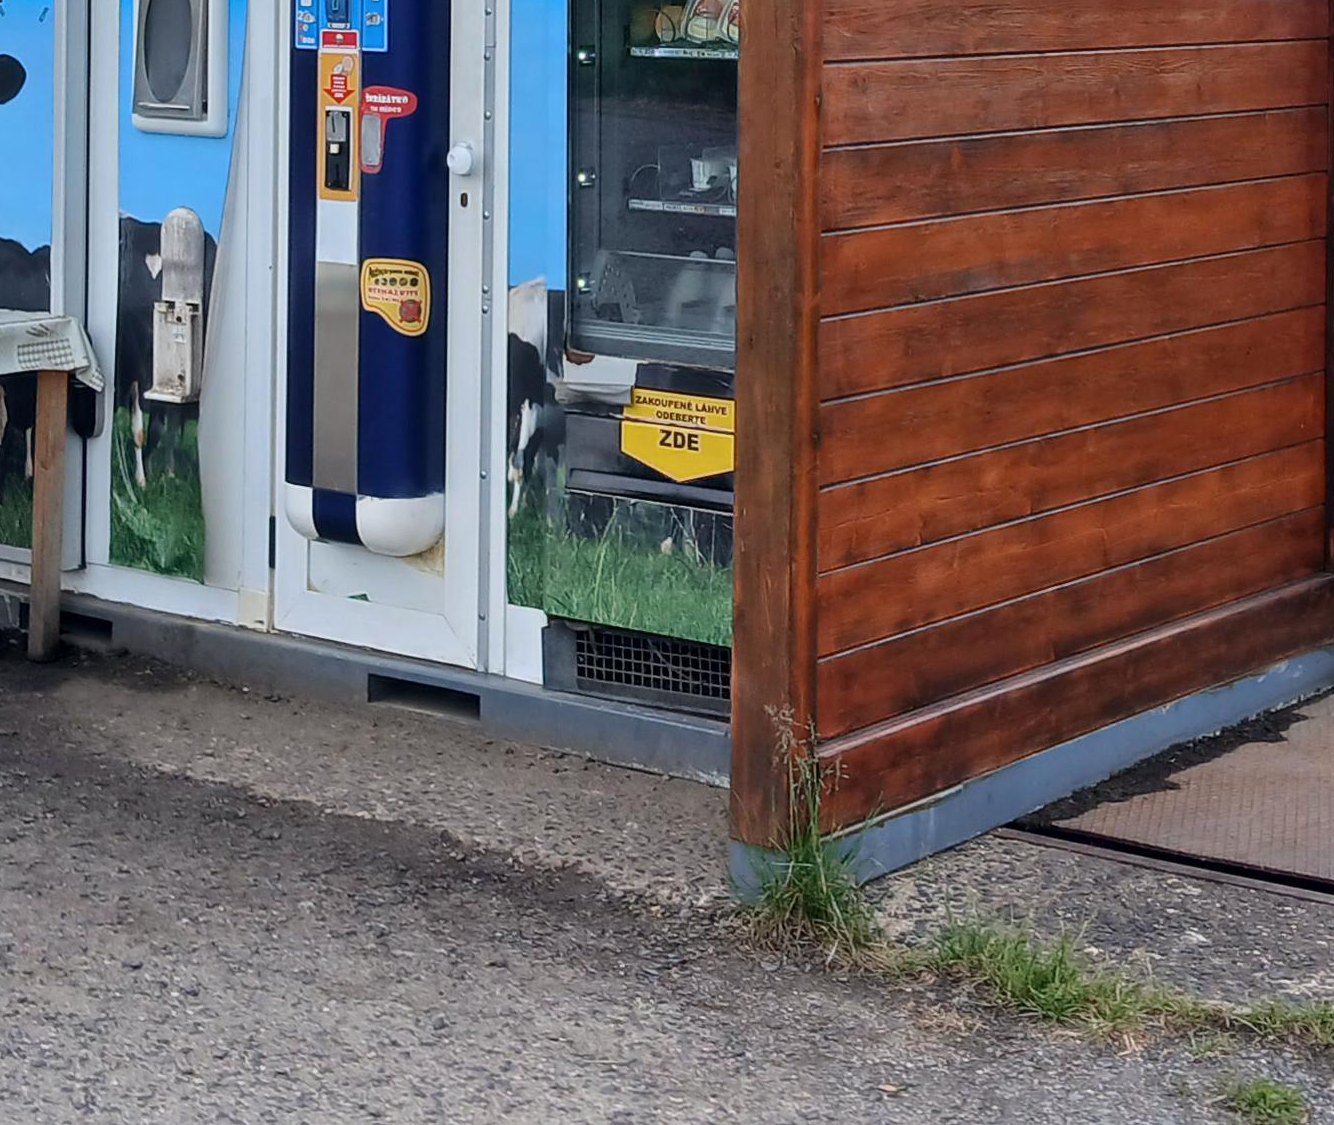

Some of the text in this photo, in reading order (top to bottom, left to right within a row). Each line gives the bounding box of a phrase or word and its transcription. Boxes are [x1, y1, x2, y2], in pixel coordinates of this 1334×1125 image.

[635, 395, 693, 411] ZAKOUPENÉ
[656, 410, 707, 425] ODEBERTE
[659, 429, 699, 452] ZDE
